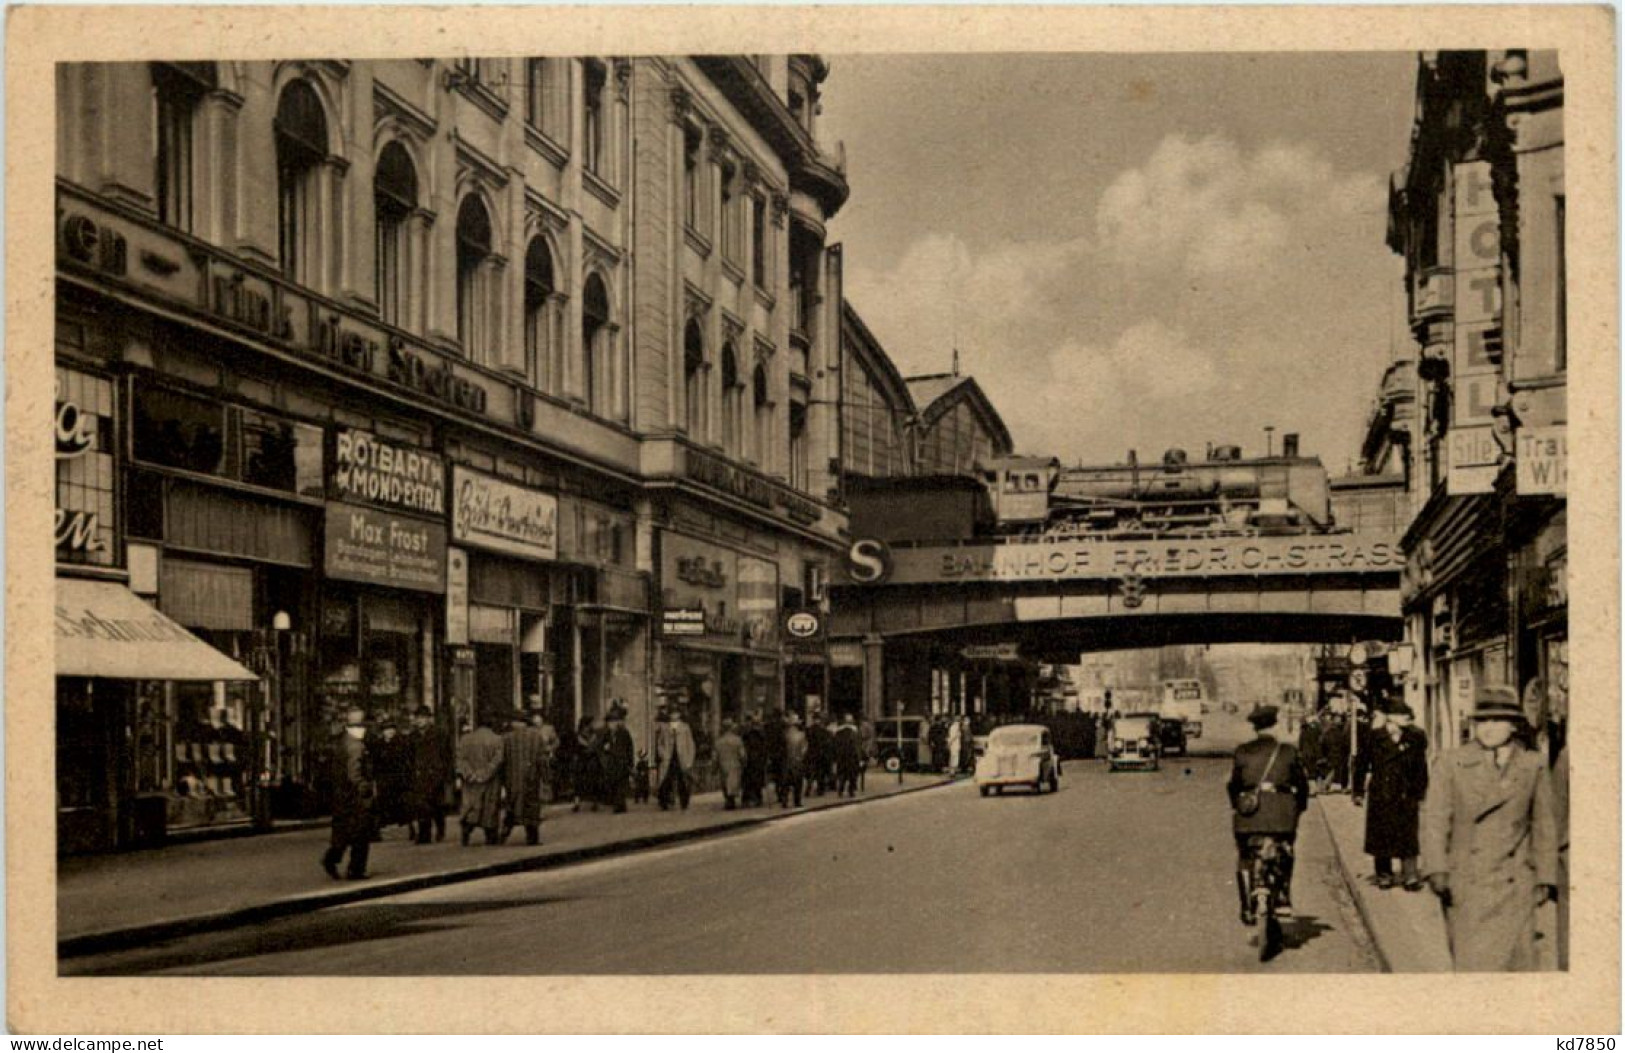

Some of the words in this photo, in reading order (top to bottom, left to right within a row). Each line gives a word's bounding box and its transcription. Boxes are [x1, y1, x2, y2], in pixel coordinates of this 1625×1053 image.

[337, 432, 432, 482] ROTBART
[350, 514, 383, 545] Max
[391, 521, 429, 552] Frost
[850, 540, 885, 582] S
[938, 551, 1089, 577] BAHNHOF
